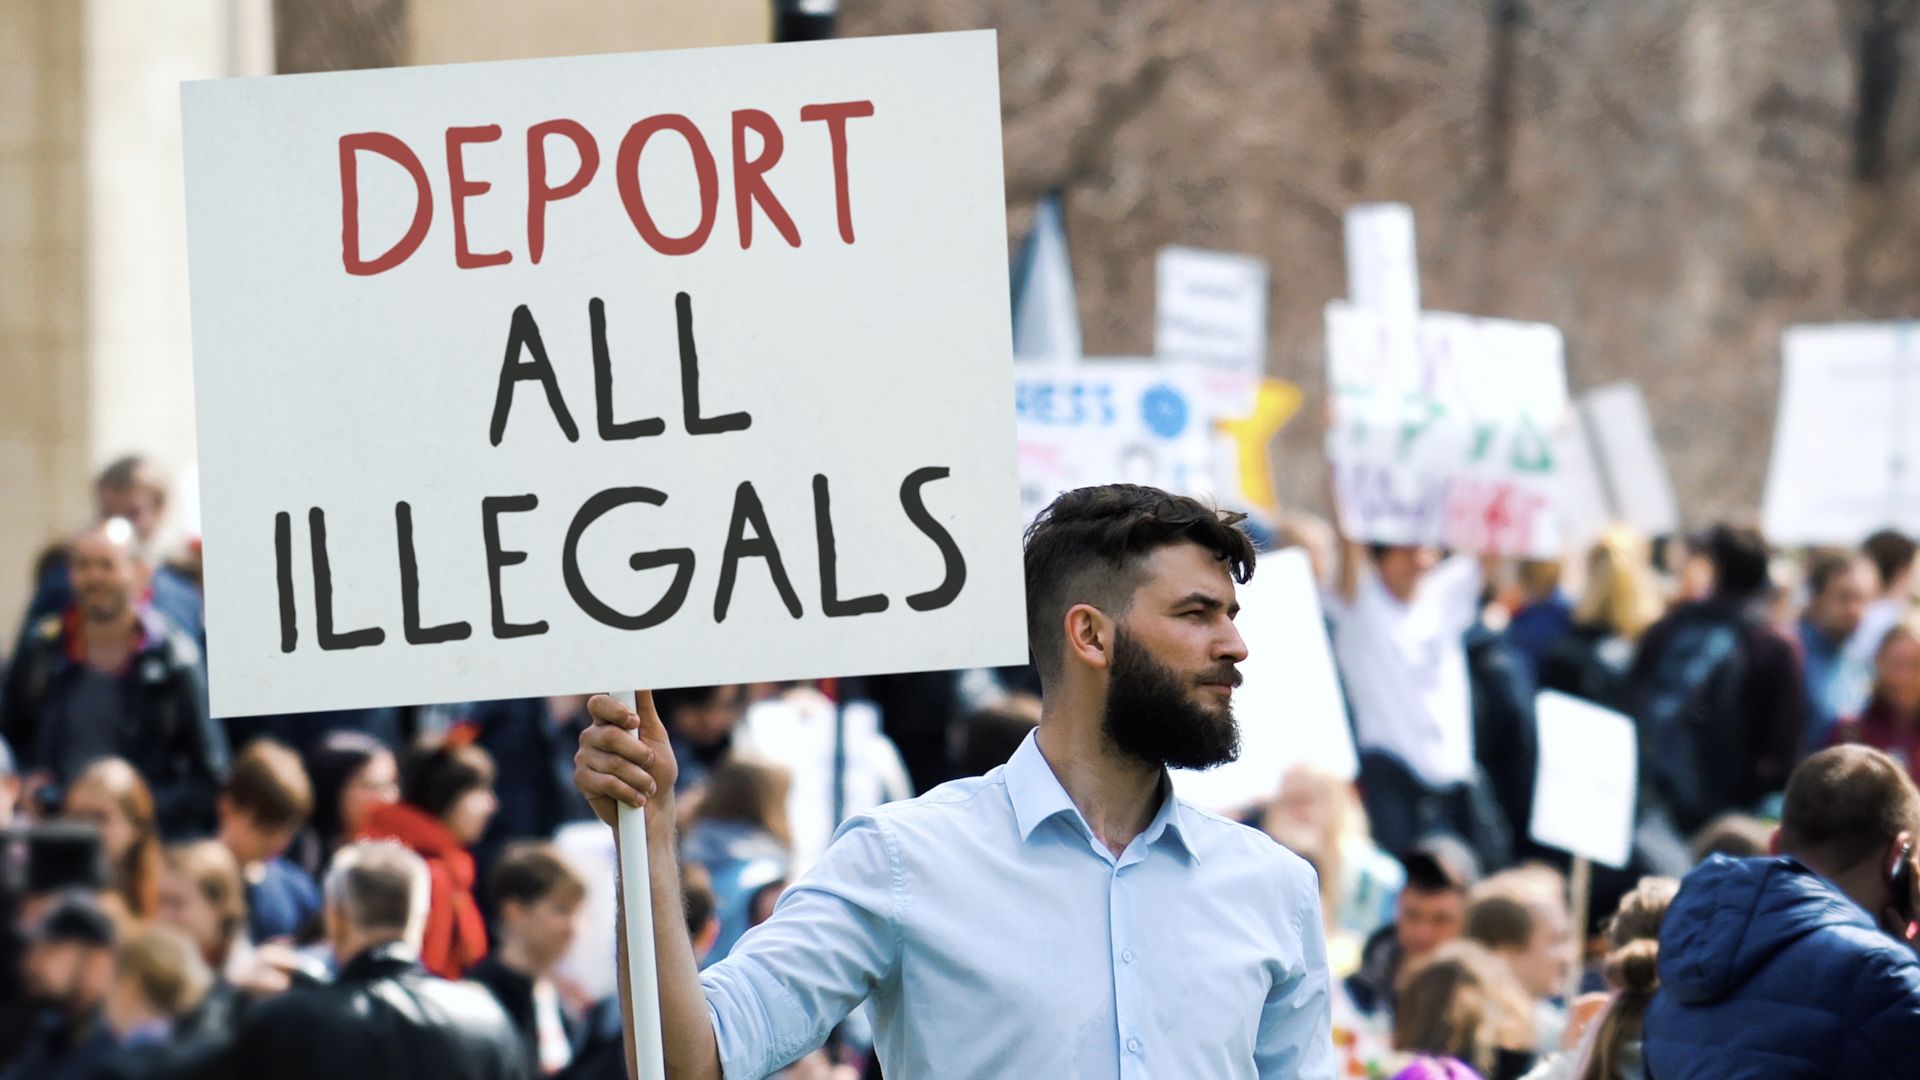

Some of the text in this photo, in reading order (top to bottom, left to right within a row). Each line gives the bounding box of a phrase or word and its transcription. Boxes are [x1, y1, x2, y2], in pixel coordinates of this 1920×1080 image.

[339, 100, 875, 276] DEPORT
[489, 291, 753, 447] ALL
[274, 466, 968, 654] ILLEGALS
